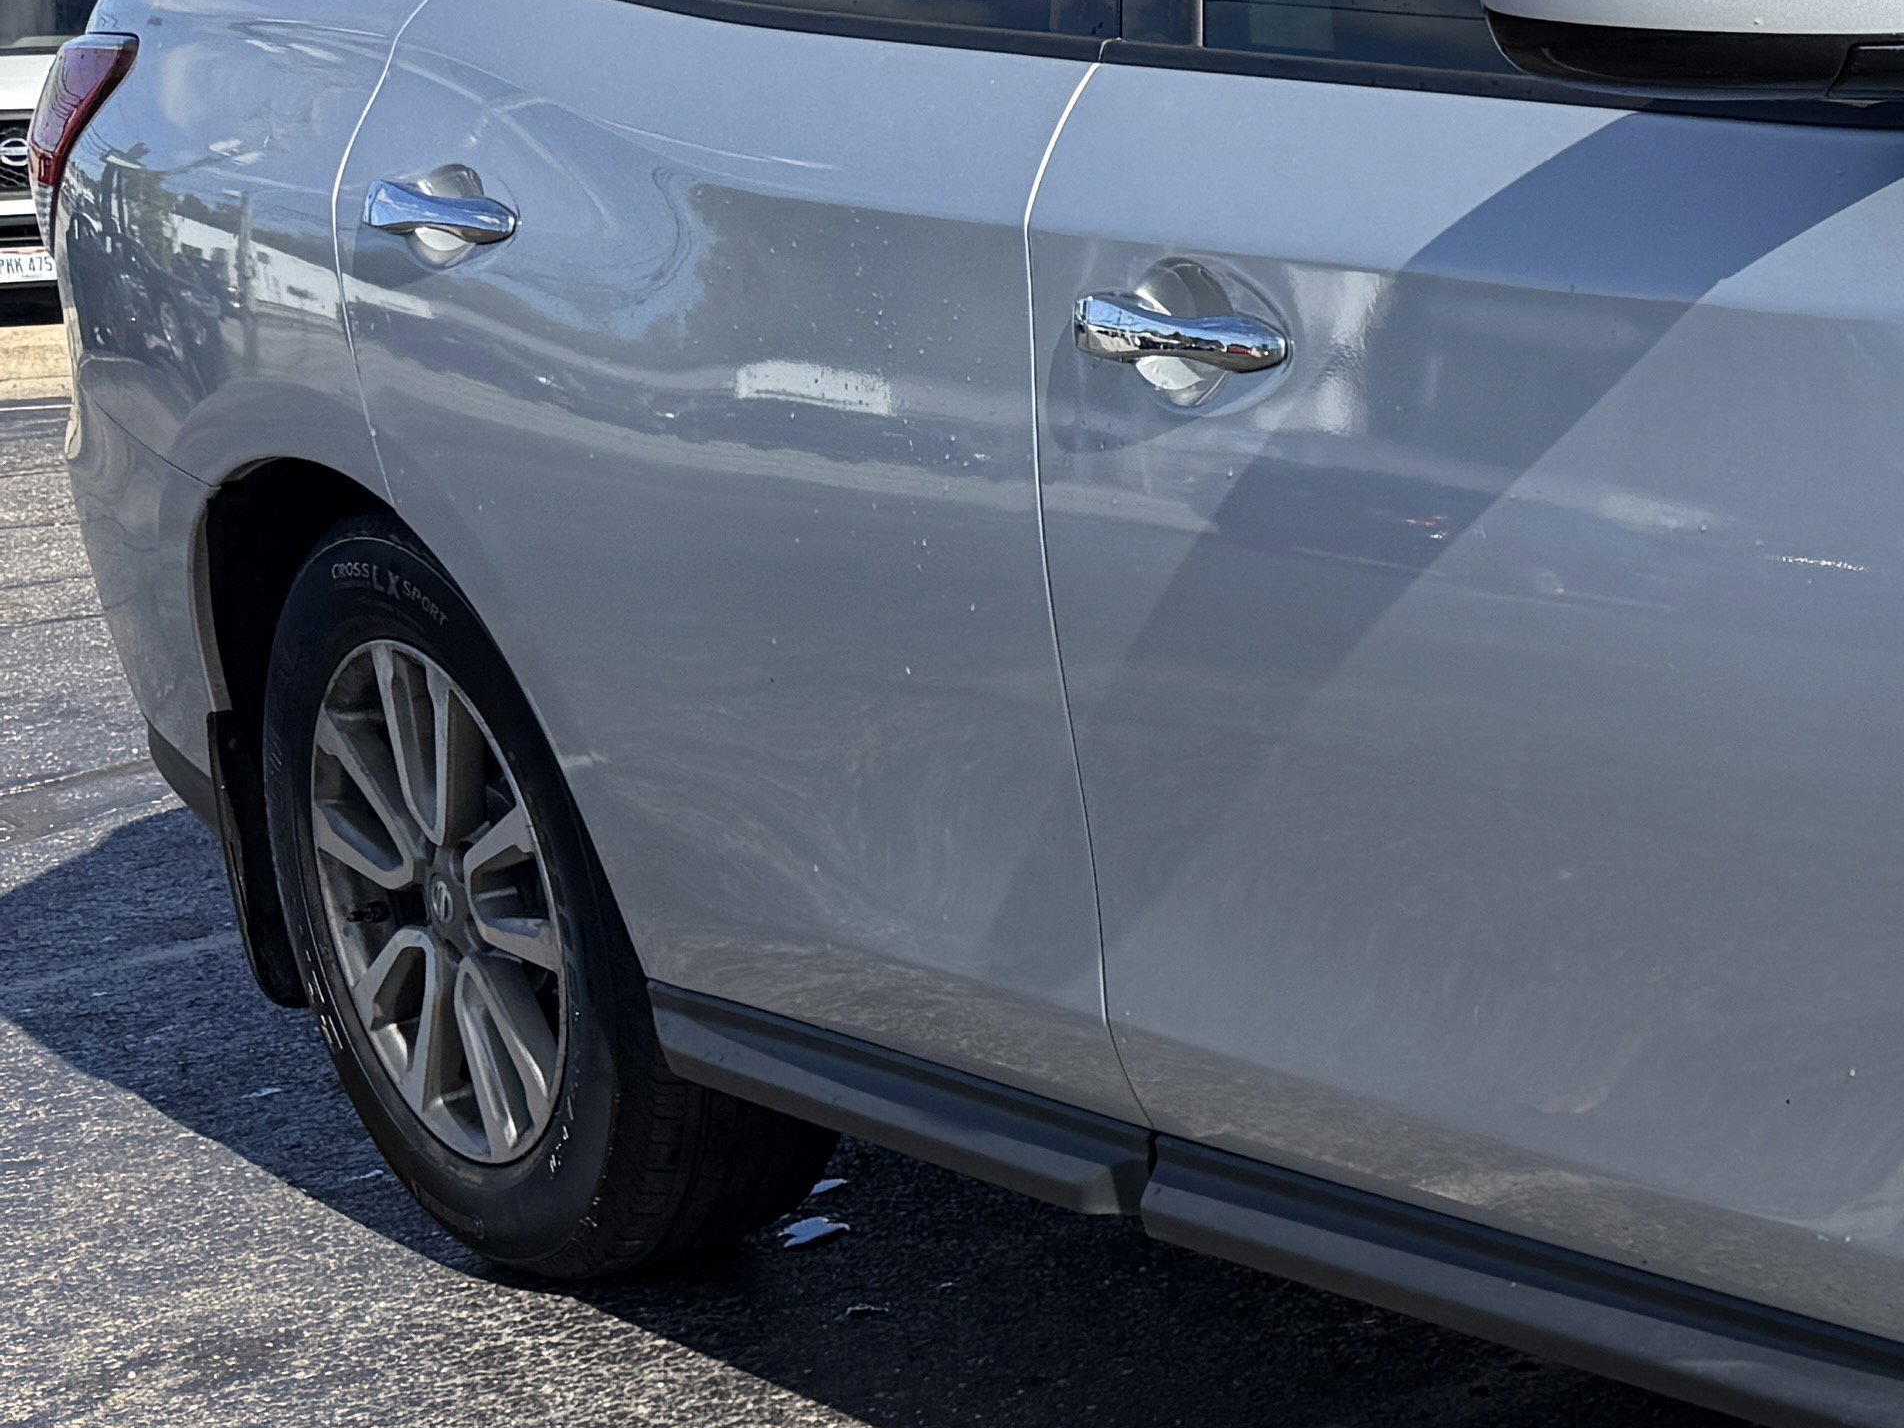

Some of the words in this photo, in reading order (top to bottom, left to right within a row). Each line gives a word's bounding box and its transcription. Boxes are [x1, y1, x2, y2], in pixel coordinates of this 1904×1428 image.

[331, 562, 370, 580] CROSS
[372, 565, 400, 600] LX
[403, 580, 448, 626] SPORT
